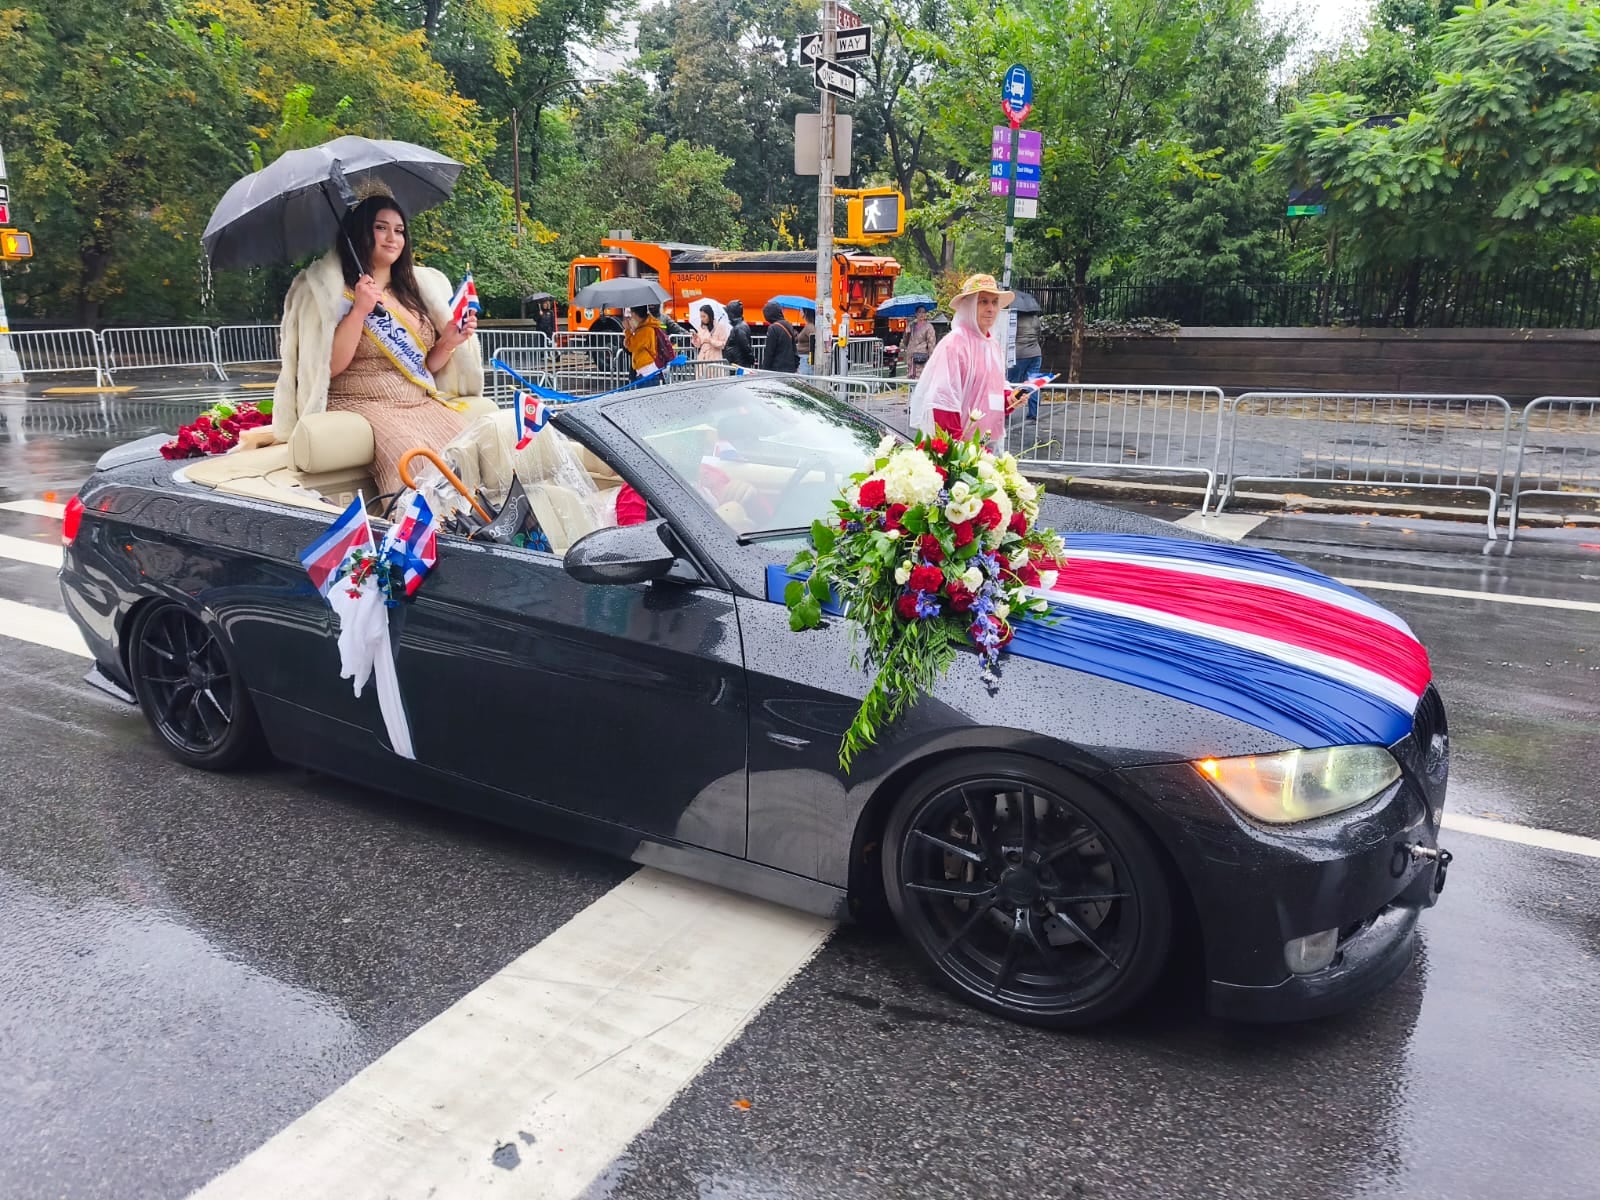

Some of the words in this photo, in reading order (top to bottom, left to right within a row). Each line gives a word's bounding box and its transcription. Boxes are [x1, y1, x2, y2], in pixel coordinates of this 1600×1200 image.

[839, 38, 860, 50] WAY
[823, 69, 835, 83] ONE
[993, 130, 1003, 142] M1
[993, 147, 1004, 159] M2
[992, 164, 1002, 176] M3
[991, 181, 1002, 193] M4
[676, 273, 708, 282] 38AF-001
